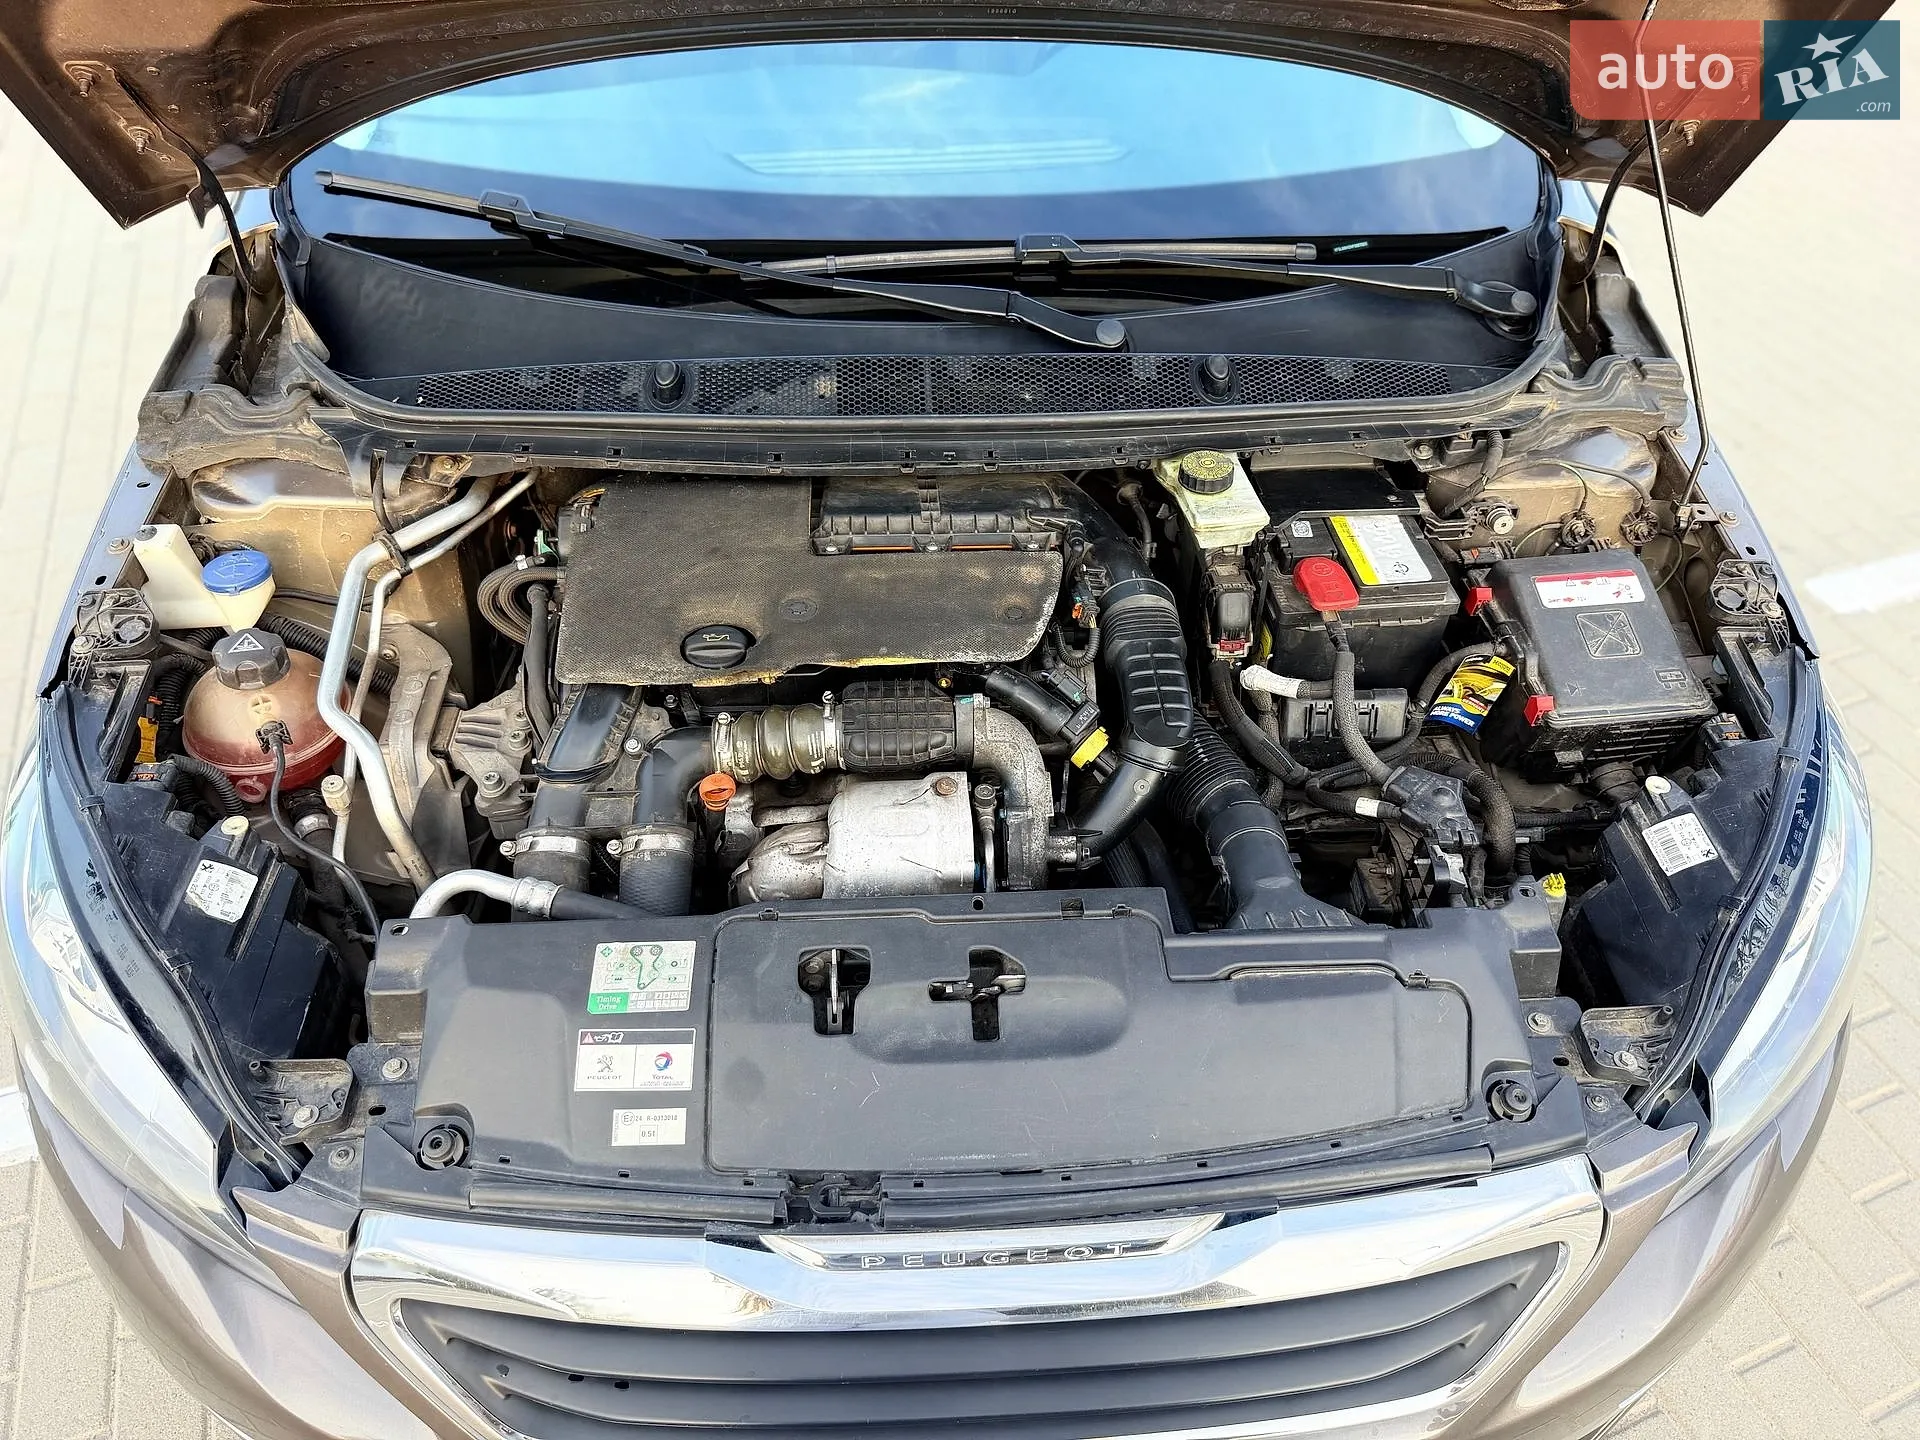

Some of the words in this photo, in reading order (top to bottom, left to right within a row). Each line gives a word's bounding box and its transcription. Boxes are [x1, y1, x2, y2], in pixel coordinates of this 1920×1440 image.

[1432, 705, 1462, 714] ALWAYS
[1448, 712, 1476, 728] POWER
[597, 995, 622, 1004] Timing
[861, 1242, 1132, 1269] PEUGEOT
